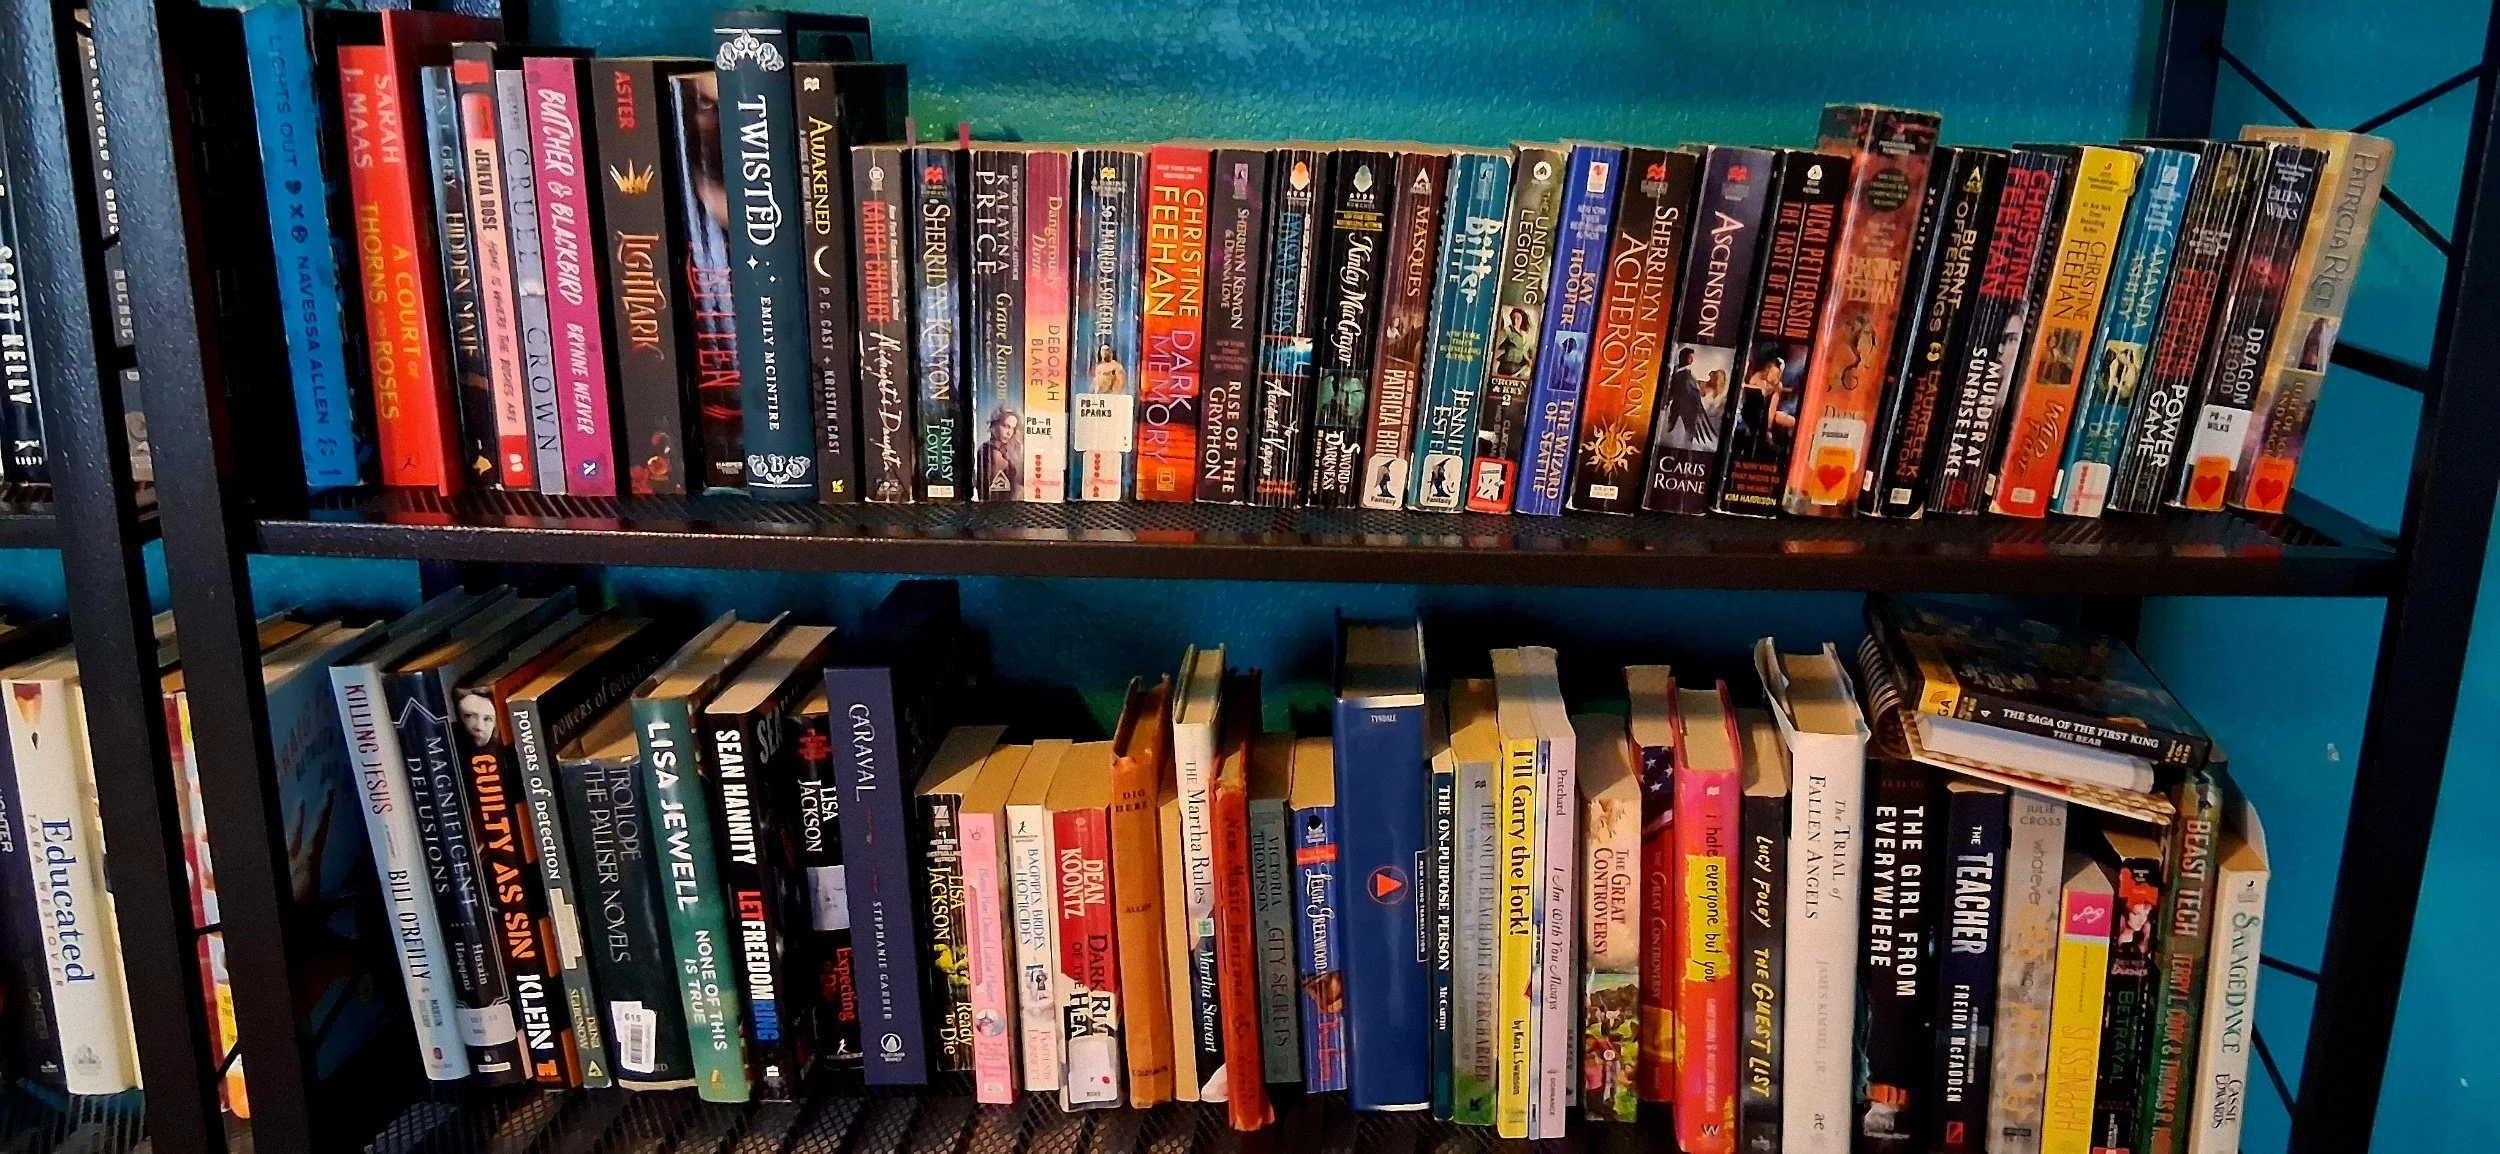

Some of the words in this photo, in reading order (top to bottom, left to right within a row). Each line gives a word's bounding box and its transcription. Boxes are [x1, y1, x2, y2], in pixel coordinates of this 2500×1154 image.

[343, 68, 364, 81] J.
[614, 71, 637, 129] ASTER
[348, 93, 373, 170] MAAS
[375, 74, 400, 163] SARAH
[538, 89, 575, 177] BUTCHER
[547, 181, 573, 198] &
[737, 95, 782, 246] TWISTED
[975, 171, 997, 275] PRICE
[996, 175, 1010, 270] KALAYNA
[1805, 204, 1836, 245] VICKI
[2329, 152, 2379, 254] PATRICIA
[360, 201, 388, 304] THORNS
[391, 244, 411, 262] A
[551, 202, 583, 306] BLACKBIRD
[1150, 186, 1180, 317] FEEHAN
[1178, 189, 1205, 318] CHRISTINE
[1407, 205, 1430, 297] MASQUES
[1512, 209, 1534, 282] LEGION
[1524, 216, 1550, 306] UNDYING
[1641, 205, 1679, 324] SHERRILYN
[1698, 211, 1744, 338] ASCENSION
[1930, 201, 1969, 332] OFFERINGS
[1948, 229, 1977, 309] BURNT
[509, 148, 539, 262] CRUEL
[527, 328, 558, 451] CROWN
[617, 231, 666, 361] LIGHTLARK
[1560, 249, 1584, 324] HOOPER
[1578, 271, 1597, 307] KAY
[1785, 249, 1828, 339] PETTERSSON
[2052, 238, 2084, 320] FEEHAN
[2080, 241, 2107, 322] CHRISTINE
[2313, 254, 2352, 309] RICE
[296, 256, 320, 351] NAVESSA
[309, 359, 329, 424] ALLEN
[396, 272, 421, 357] COURT
[760, 296, 774, 345] EMILY
[1600, 232, 1648, 389] ACHERON
[374, 341, 399, 420] ROSES
[567, 323, 588, 377] BRYNNE
[1031, 339, 1044, 387] BLAKE
[1047, 325, 1063, 401] DEBORAH
[1169, 330, 1196, 412] DARK
[1624, 330, 1658, 418] KENYON
[2234, 328, 2264, 405] DRAGON
[573, 379, 595, 435] WEAVER
[764, 352, 779, 430] MCINTIRE
[1080, 409, 1112, 417] SPARKS
[1145, 335, 1171, 464] MEMORY
[1229, 381, 1241, 418] RISE
[1379, 369, 1407, 426] PATRICIA
[1502, 395, 1511, 406] 2
[1546, 401, 1558, 421] OF
[1557, 399, 1575, 429] THE
[1955, 347, 1987, 432] SUNRISE
[1970, 361, 2001, 442] MURDER
[925, 424, 940, 479] LOVER
[1027, 427, 1052, 435] BLAKE
[1205, 386, 1227, 480] GRYPHON
[1228, 424, 1238, 444] OF
[2137, 390, 2167, 455] GAME
[2151, 384, 2188, 468] POWER
[1221, 457, 1235, 493] THE
[1533, 425, 1556, 492] SEATTLE
[1546, 432, 1571, 499] WIZARD
[1654, 473, 1706, 494] ROANE
[1659, 457, 1706, 477] CARIS
[1944, 434, 1964, 478] LAKE
[1965, 445, 1982, 467] AT
[1725, 493, 1741, 502] KIM
[1741, 494, 1777, 505] HARRISON
[1370, 713, 1398, 724] TYNDALE
[2003, 708, 2025, 720] THE
[2027, 713, 2054, 726] SAGA
[2057, 720, 2071, 729] OF
[2074, 723, 2096, 735] THE
[2098, 728, 2128, 741] FIRST
[2130, 734, 2159, 748] KING
[2053, 730, 2073, 740] THE
[2076, 734, 2102, 746] BEAR
[344, 684, 380, 752] KILLING
[363, 757, 394, 816] JESUS
[647, 721, 679, 790] LISA
[716, 730, 740, 781] SEAN
[848, 703, 877, 803] CARAVAL
[1185, 759, 1196, 785] THE
[1512, 749, 1534, 779] I'll
[424, 737, 479, 908] MAGNIFICENT
[471, 754, 510, 854] GUILTY
[798, 779, 823, 853] JACKSON
[820, 786, 839, 822] LISA
[1186, 788, 1209, 853] Martha
[1438, 785, 1451, 814] THE
[1510, 781, 1532, 838] Carry
[1556, 768, 1568, 817] Pritchard
[1706, 813, 1715, 823] i
[1806, 774, 1828, 849] FALLEN
[1833, 799, 1846, 821] The
[2019, 815, 2061, 826] CROSS
[406, 757, 450, 896] DELUSIONS
[723, 784, 757, 865] HANNITY
[1706, 827, 1719, 858] hate
[1832, 825, 1853, 882] TRIAL
[1903, 806, 1924, 850] THE
[1972, 825, 1982, 845] THE
[387, 869, 412, 903] BILL
[491, 862, 523, 904] AS
[662, 800, 700, 912] JEWELL
[1061, 848, 1085, 920] KOONTZ
[1082, 859, 1105, 906] DEAN
[1192, 854, 1211, 905] Rules
[1254, 829, 1269, 913] THOMPSON
[1269, 835, 1283, 909] VICTORIA
[1438, 820, 1450, 910] ON-PURPOSE
[1509, 840, 1529, 873] the
[1615, 848, 1629, 875] THE
[1804, 852, 1828, 920] ANGELS
[1869, 806, 1897, 968] EVERYWHERE
[27, 813, 44, 864] TARA
[38, 881, 64, 987] WESTOVER
[41, 817, 95, 984] Educated
[928, 867, 950, 941] JACKSON
[1508, 877, 1529, 936] Fork!
[1592, 847, 1613, 957] CONTROVERSY
[1610, 877, 1630, 925] GREAT
[1691, 857, 1720, 927] everyone
[1830, 886, 1842, 900] of
[1900, 858, 1922, 920] GIRL
[1951, 852, 1994, 955] TEACHER
[398, 906, 433, 981] O'REILLY
[471, 944, 488, 985] Husain
[503, 913, 535, 959] SIN
[697, 929, 716, 978] NONE
[872, 901, 889, 966] STEPHANIE
[1088, 934, 1108, 992] DARK
[1438, 916, 1450, 970] PERSON
[1706, 930, 1720, 956] but
[1754, 947, 1769, 980] THE
[1897, 930, 1918, 996] FROM
[684, 959, 695, 975] IS
[704, 983, 721, 1003] OF
[880, 970, 892, 1021] GARBER
[1199, 949, 1214, 999] Martha
[1698, 957, 1718, 982] you
[517, 974, 555, 1050] KLEIN
[687, 978, 706, 1025] TRUE
[710, 1008, 728, 1051] THIS
[956, 1001, 973, 1046] Ready
[1202, 1001, 1217, 1053] Stewart
[1750, 981, 1775, 1053] GUEST
[1951, 984, 1970, 1031] FREIDA
[2110, 991, 2134, 1082] BETRAYAL
[1750, 1056, 1771, 1099] LIST
